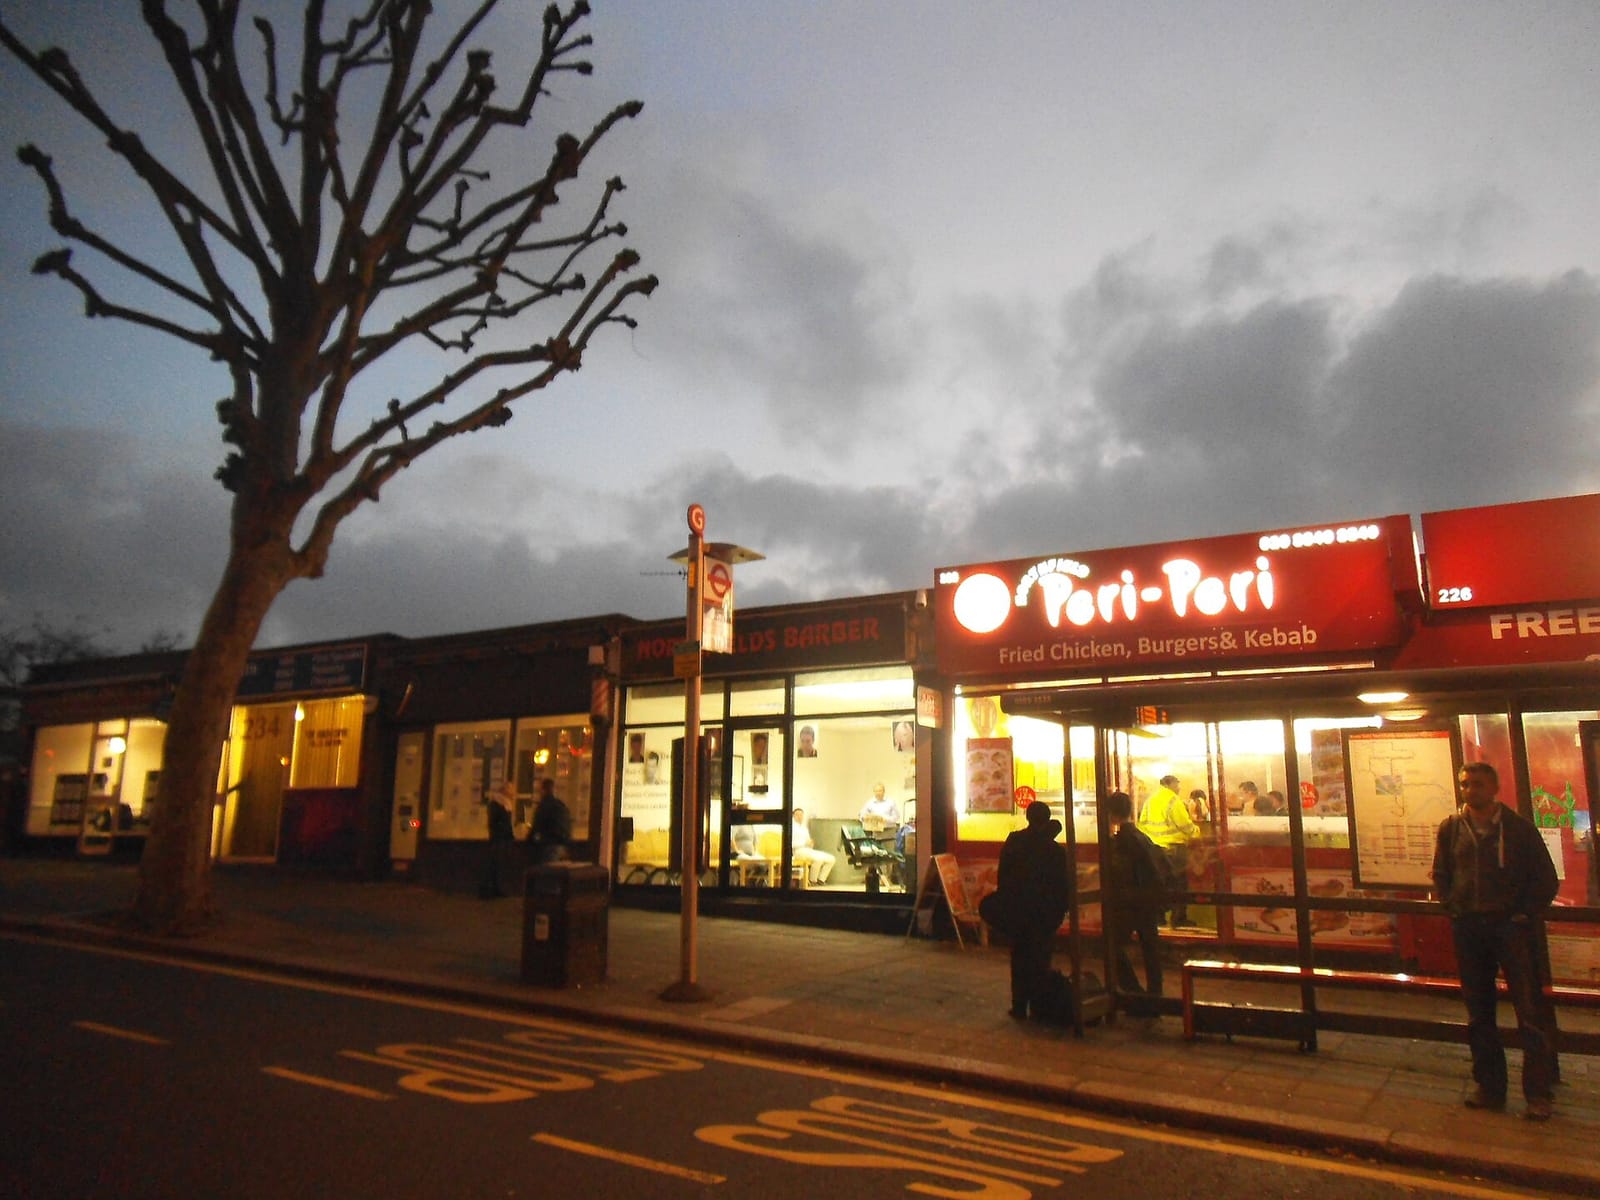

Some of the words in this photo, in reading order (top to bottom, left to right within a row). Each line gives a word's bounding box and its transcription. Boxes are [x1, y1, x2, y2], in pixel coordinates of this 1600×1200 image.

[691, 507, 704, 528] G
[1037, 555, 1275, 628] Peri-Peri
[1438, 586, 1473, 603] 226
[784, 616, 880, 650] BARBER
[1490, 607, 1600, 640] FREE
[999, 646, 1045, 664] Fried
[1049, 640, 1132, 662] Chicken,
[1244, 624, 1319, 649] Kebab
[243, 716, 281, 741] 234
